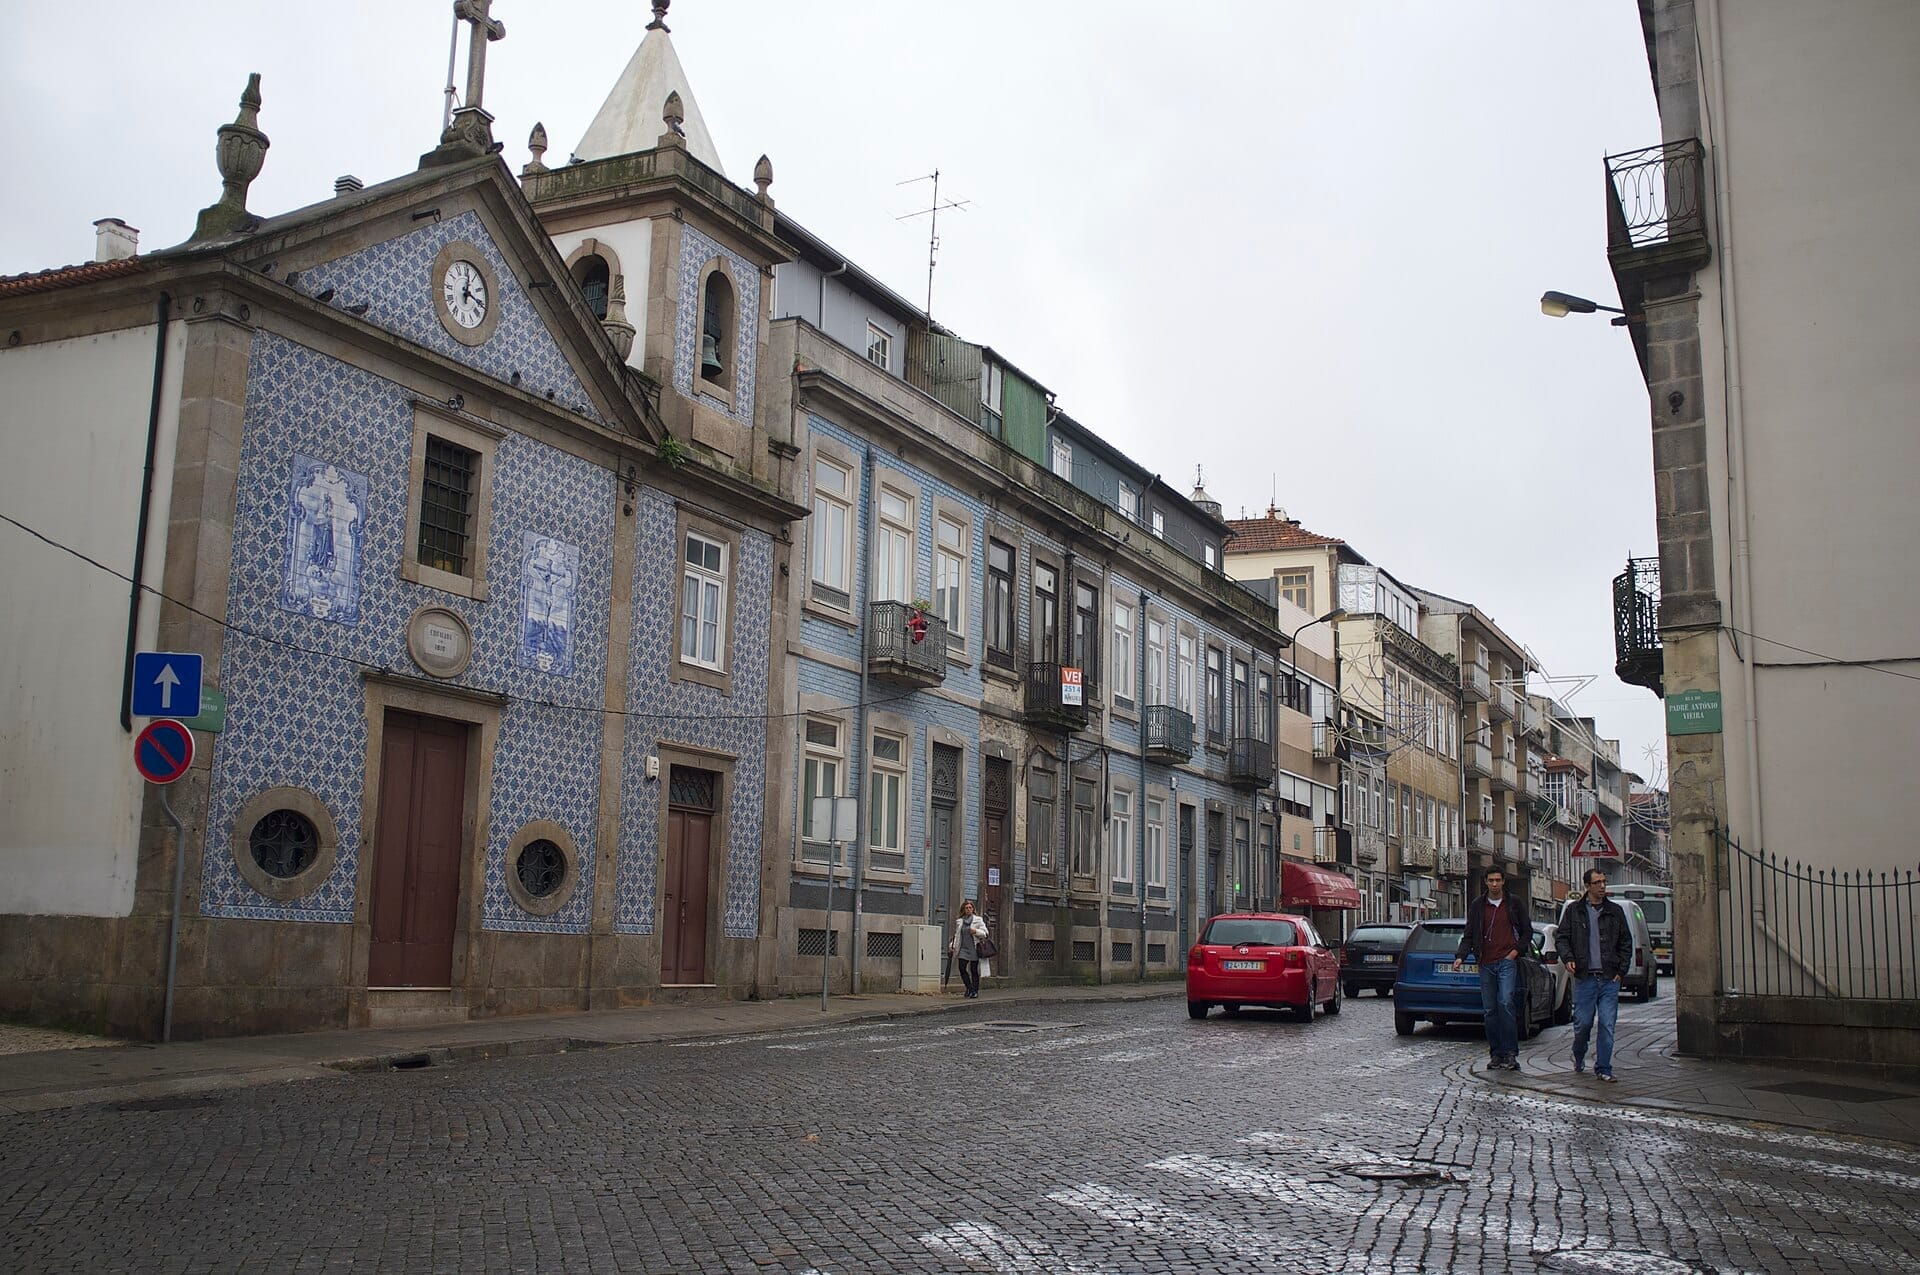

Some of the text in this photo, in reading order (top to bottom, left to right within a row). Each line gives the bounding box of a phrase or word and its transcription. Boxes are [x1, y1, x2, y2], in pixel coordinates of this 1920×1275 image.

[1669, 701, 1718, 712] PADRE ANTÓNIO
[1682, 711, 1705, 720] VIEIRA
